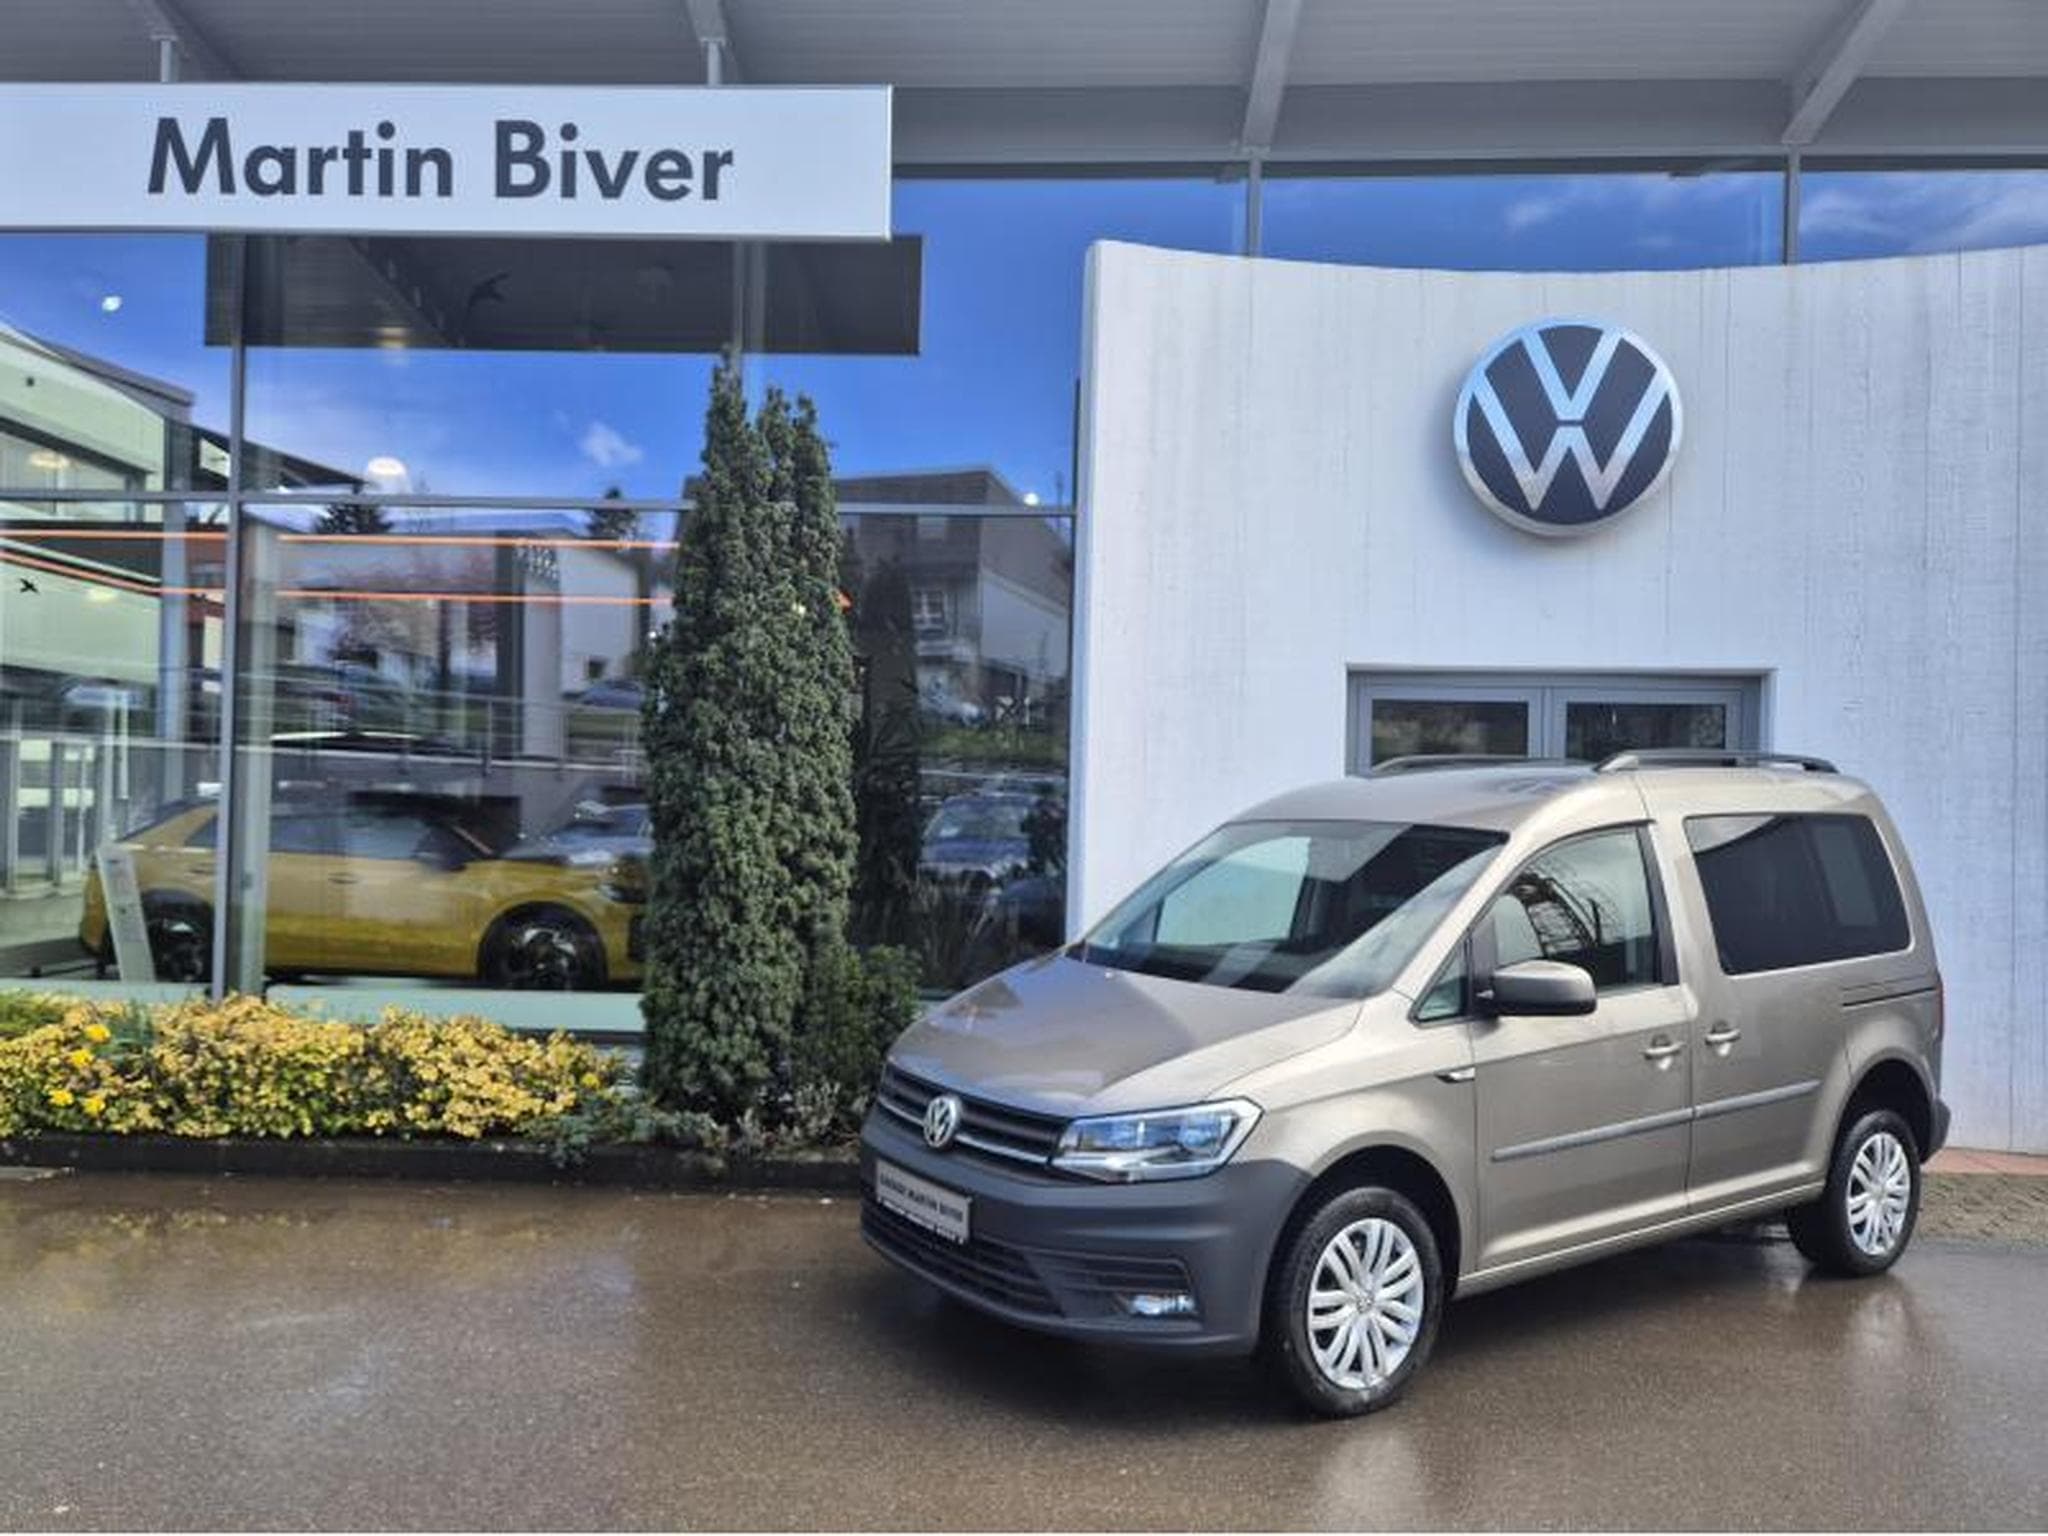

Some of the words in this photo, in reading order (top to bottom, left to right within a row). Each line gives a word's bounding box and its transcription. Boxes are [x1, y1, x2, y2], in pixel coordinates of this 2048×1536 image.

[147, 117, 453, 198] Martin
[495, 119, 734, 202] Biver
[1466, 322, 1674, 514] VW
